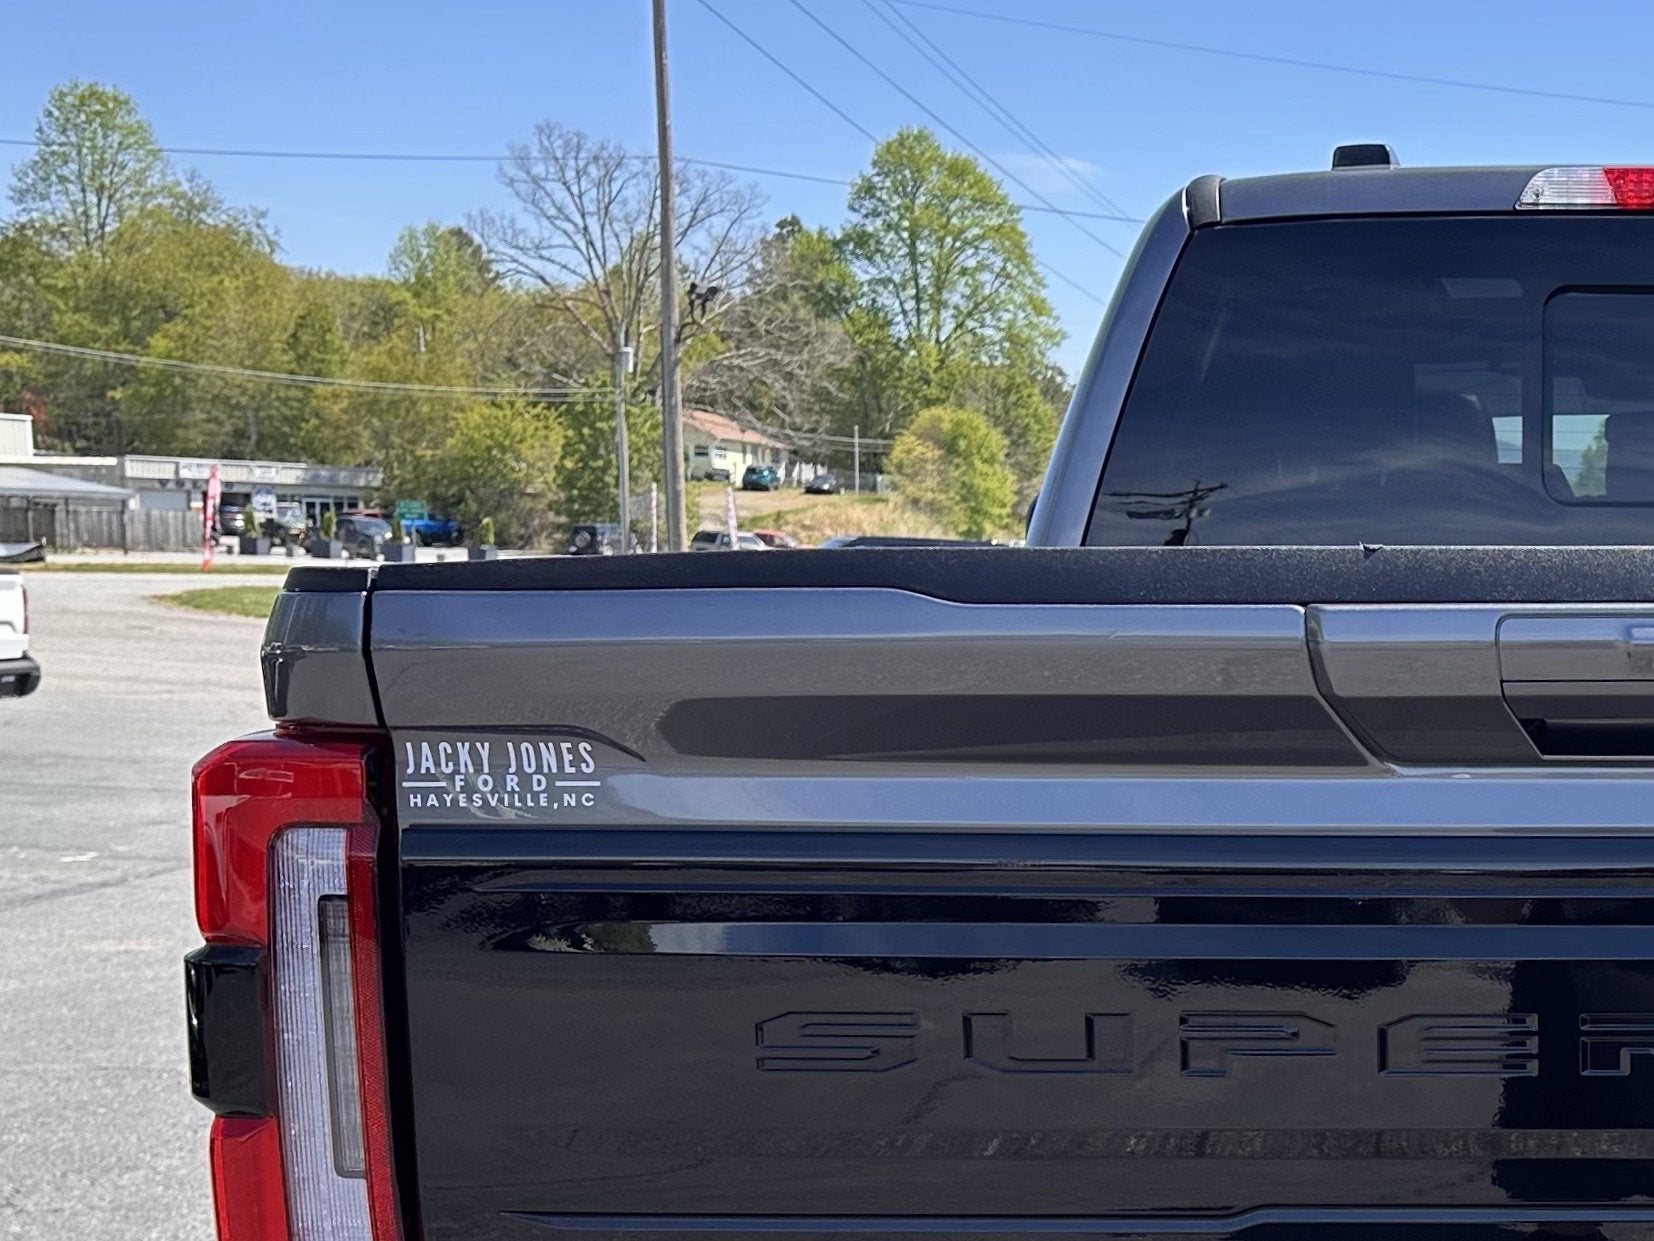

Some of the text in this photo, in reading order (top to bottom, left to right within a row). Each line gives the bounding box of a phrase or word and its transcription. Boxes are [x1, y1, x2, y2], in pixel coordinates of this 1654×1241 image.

[405, 741, 596, 774] JACKY JONES
[455, 774, 548, 792] FORD
